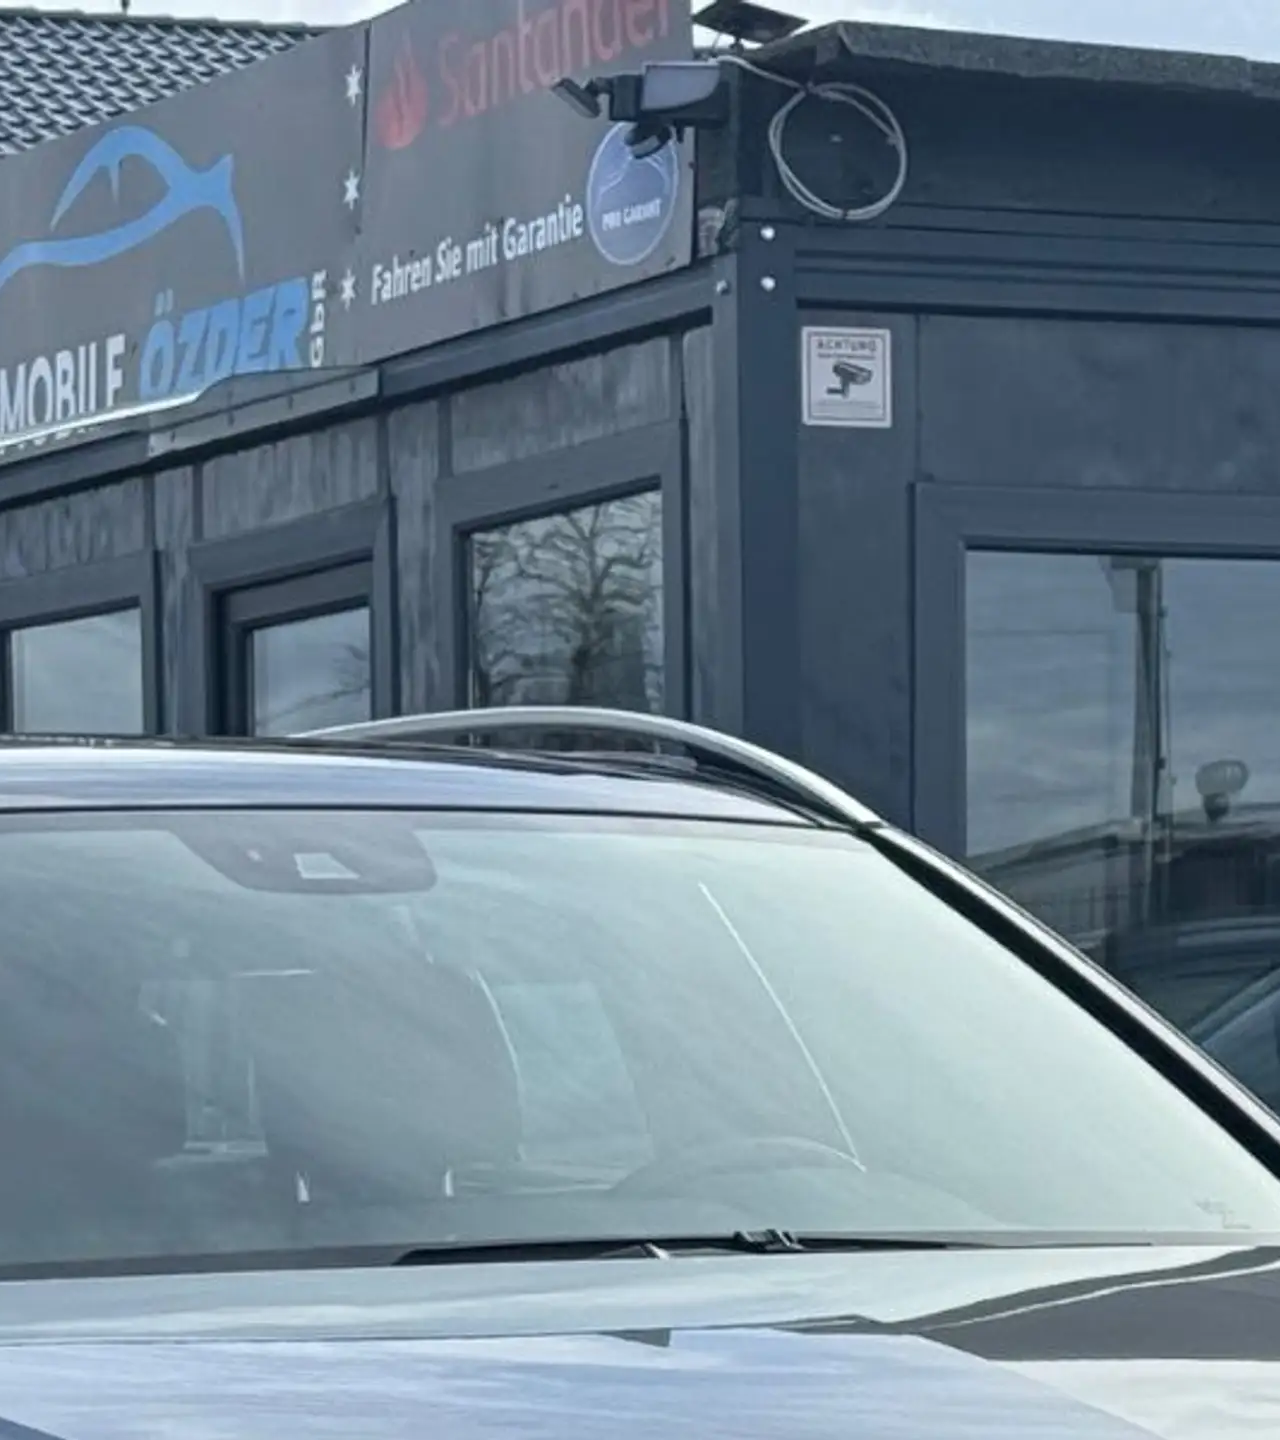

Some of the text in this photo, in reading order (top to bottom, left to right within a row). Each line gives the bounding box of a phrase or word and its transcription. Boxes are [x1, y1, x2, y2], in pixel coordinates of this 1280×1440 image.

[372, 194, 583, 305] Fahren Sie mit Garantie
[139, 276, 311, 400] ÖZDER
